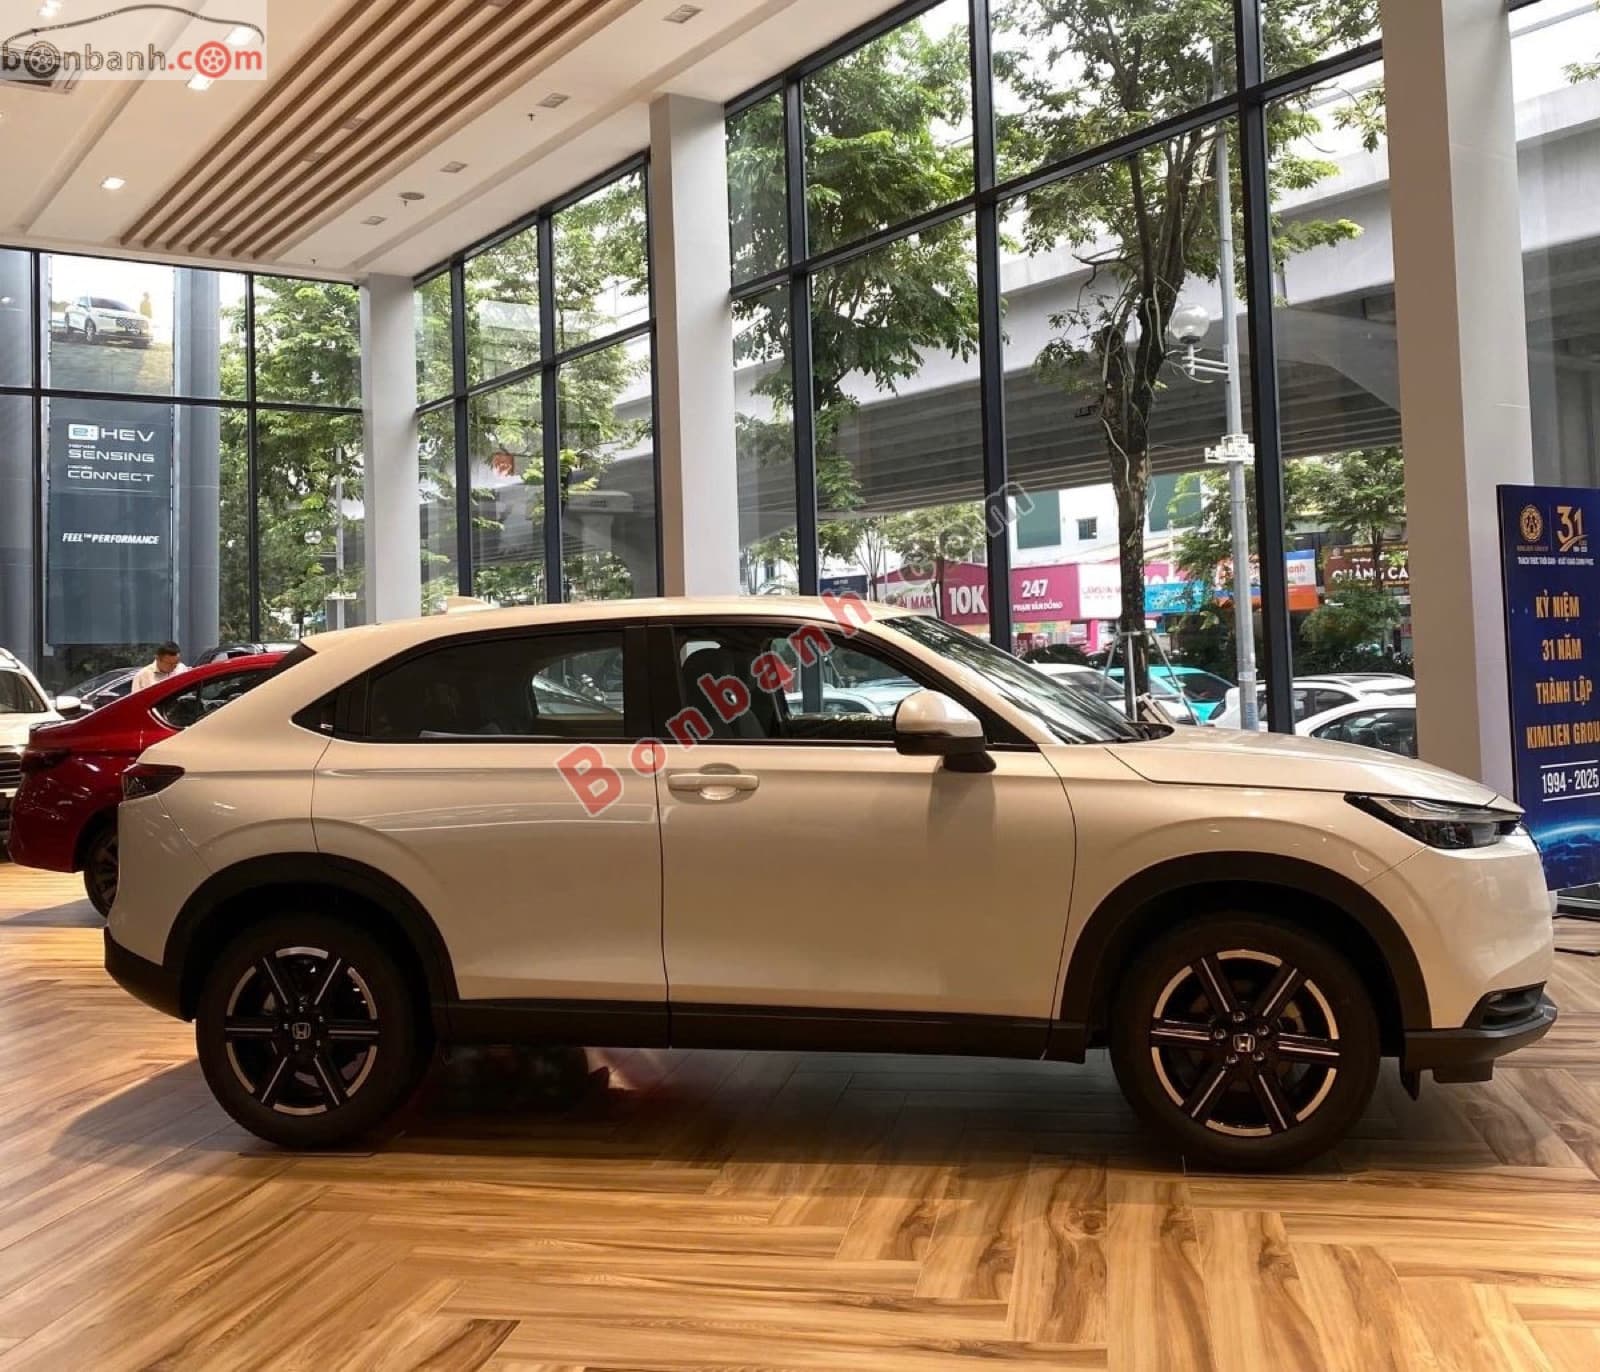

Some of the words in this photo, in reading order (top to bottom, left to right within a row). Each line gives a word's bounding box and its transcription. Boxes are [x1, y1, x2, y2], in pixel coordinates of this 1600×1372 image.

[68, 449, 155, 462] SENSING
[67, 470, 155, 482] CONNECT
[62, 533, 83, 542] FEEL
[92, 534, 159, 544] PERFORMANCE
[948, 585, 988, 615] 10K
[1021, 579, 1048, 598] 247
[1552, 591, 1580, 622] NIỆM
[1542, 640, 1554, 661] 31
[1557, 633, 1582, 660] NĂM
[1536, 676, 1570, 705] THÀNH
[1573, 675, 1593, 706] LẬP
[1526, 724, 1570, 749] KIMLIEN
[1542, 771, 1566, 794] 1994
[1574, 768, 1599, 790] 2025
